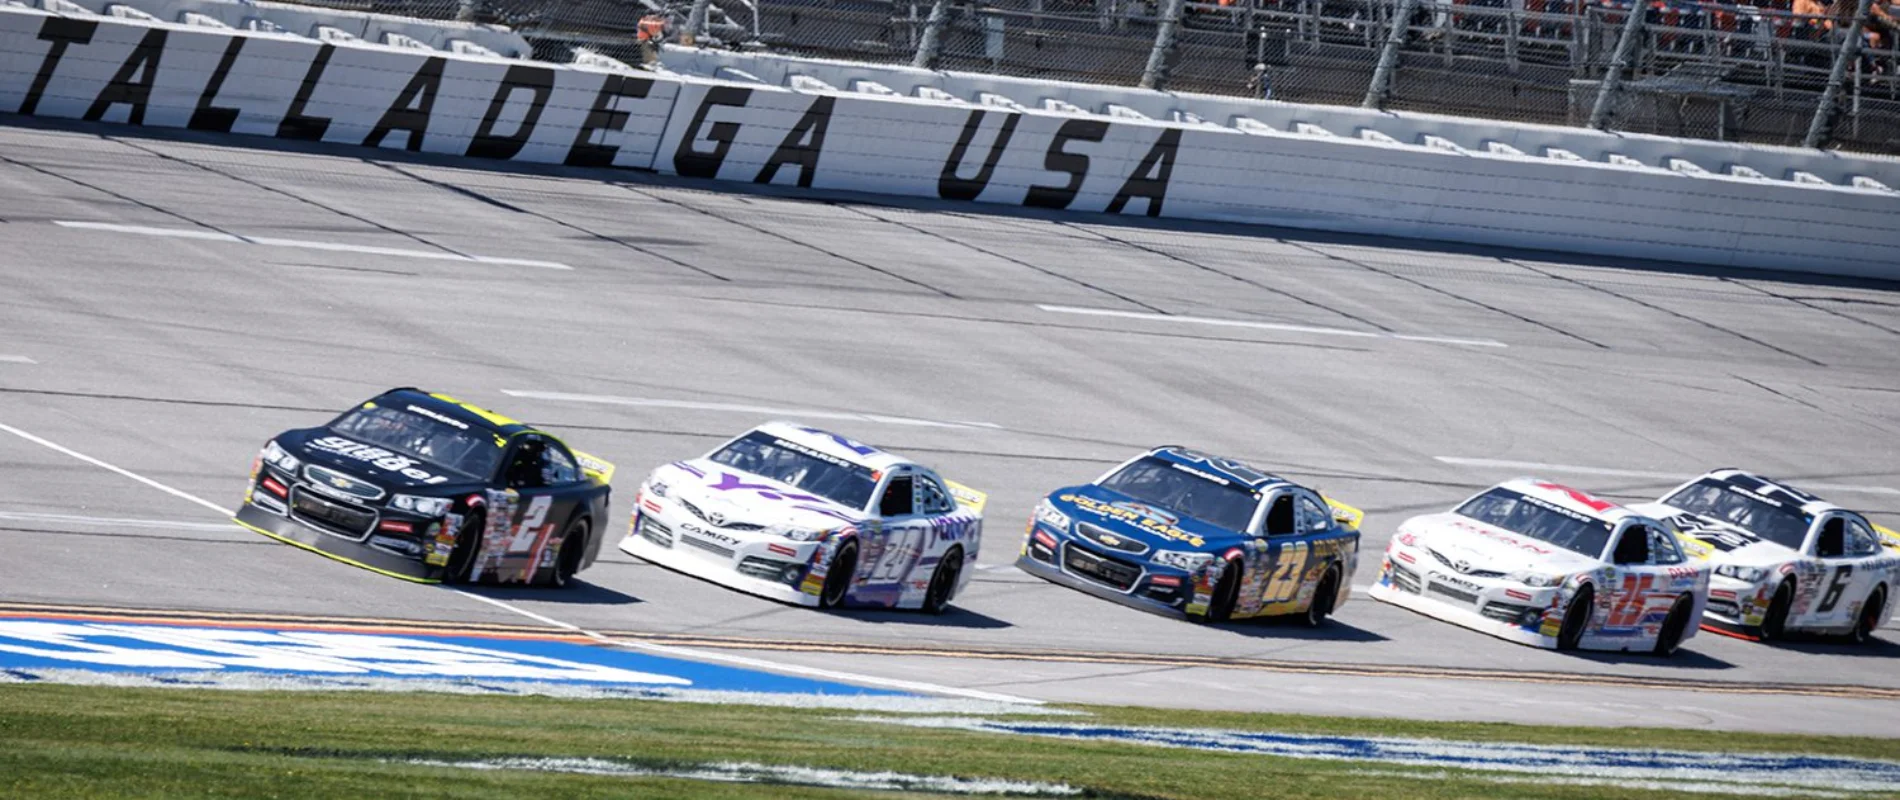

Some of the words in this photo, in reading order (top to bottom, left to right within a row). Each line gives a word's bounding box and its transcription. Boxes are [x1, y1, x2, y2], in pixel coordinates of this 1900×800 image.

[18, 16, 837, 189] TALLADEGA
[937, 108, 1184, 218] USA
[508, 495, 552, 553] 2
[680, 521, 742, 546] CAMRY
[1060, 493, 1138, 520] GOLDEN
[1141, 515, 1207, 548] EAGLE
[867, 526, 923, 581] 20
[1261, 540, 1309, 603] 23
[1427, 569, 1486, 592] CAMRY
[1605, 572, 1655, 628] 25
[1815, 564, 1853, 613] 6
